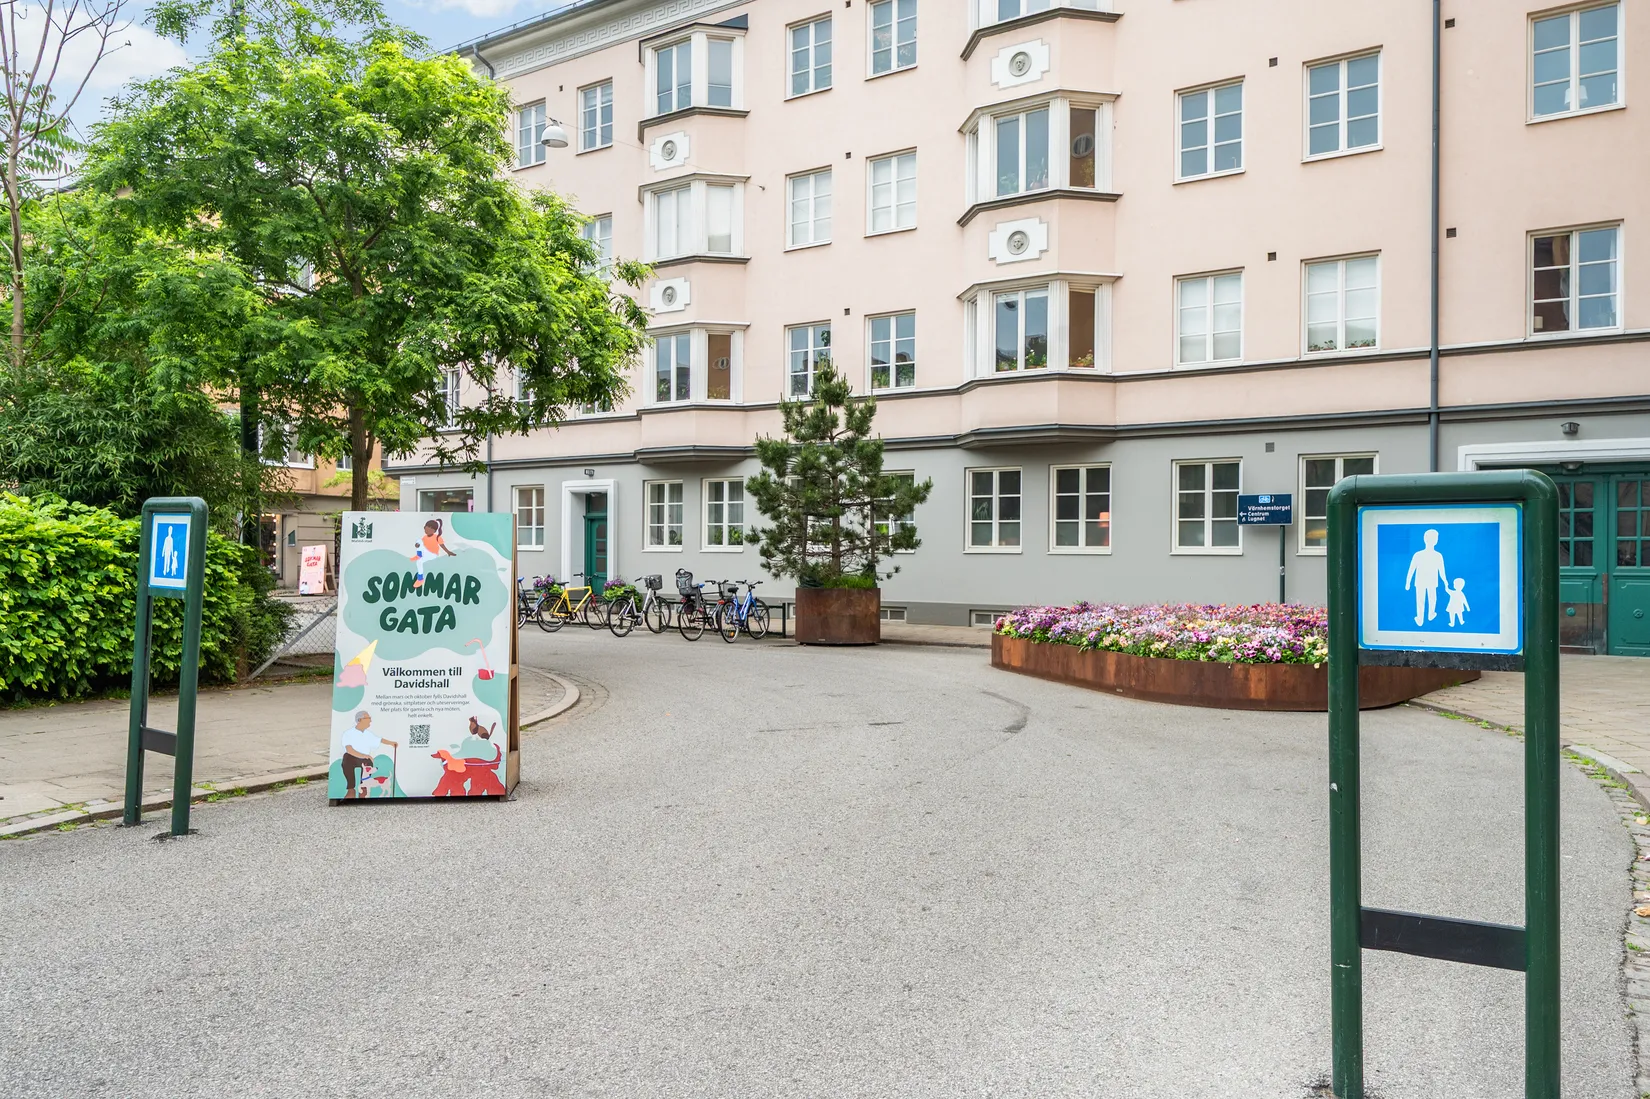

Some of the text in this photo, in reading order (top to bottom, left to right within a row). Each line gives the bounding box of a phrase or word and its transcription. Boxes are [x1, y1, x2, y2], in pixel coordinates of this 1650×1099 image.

[362, 571, 482, 606] SOMMAR
[379, 605, 457, 635] GATA
[382, 666, 463, 677] Välkommen till
[394, 678, 450, 689] Davidshall
